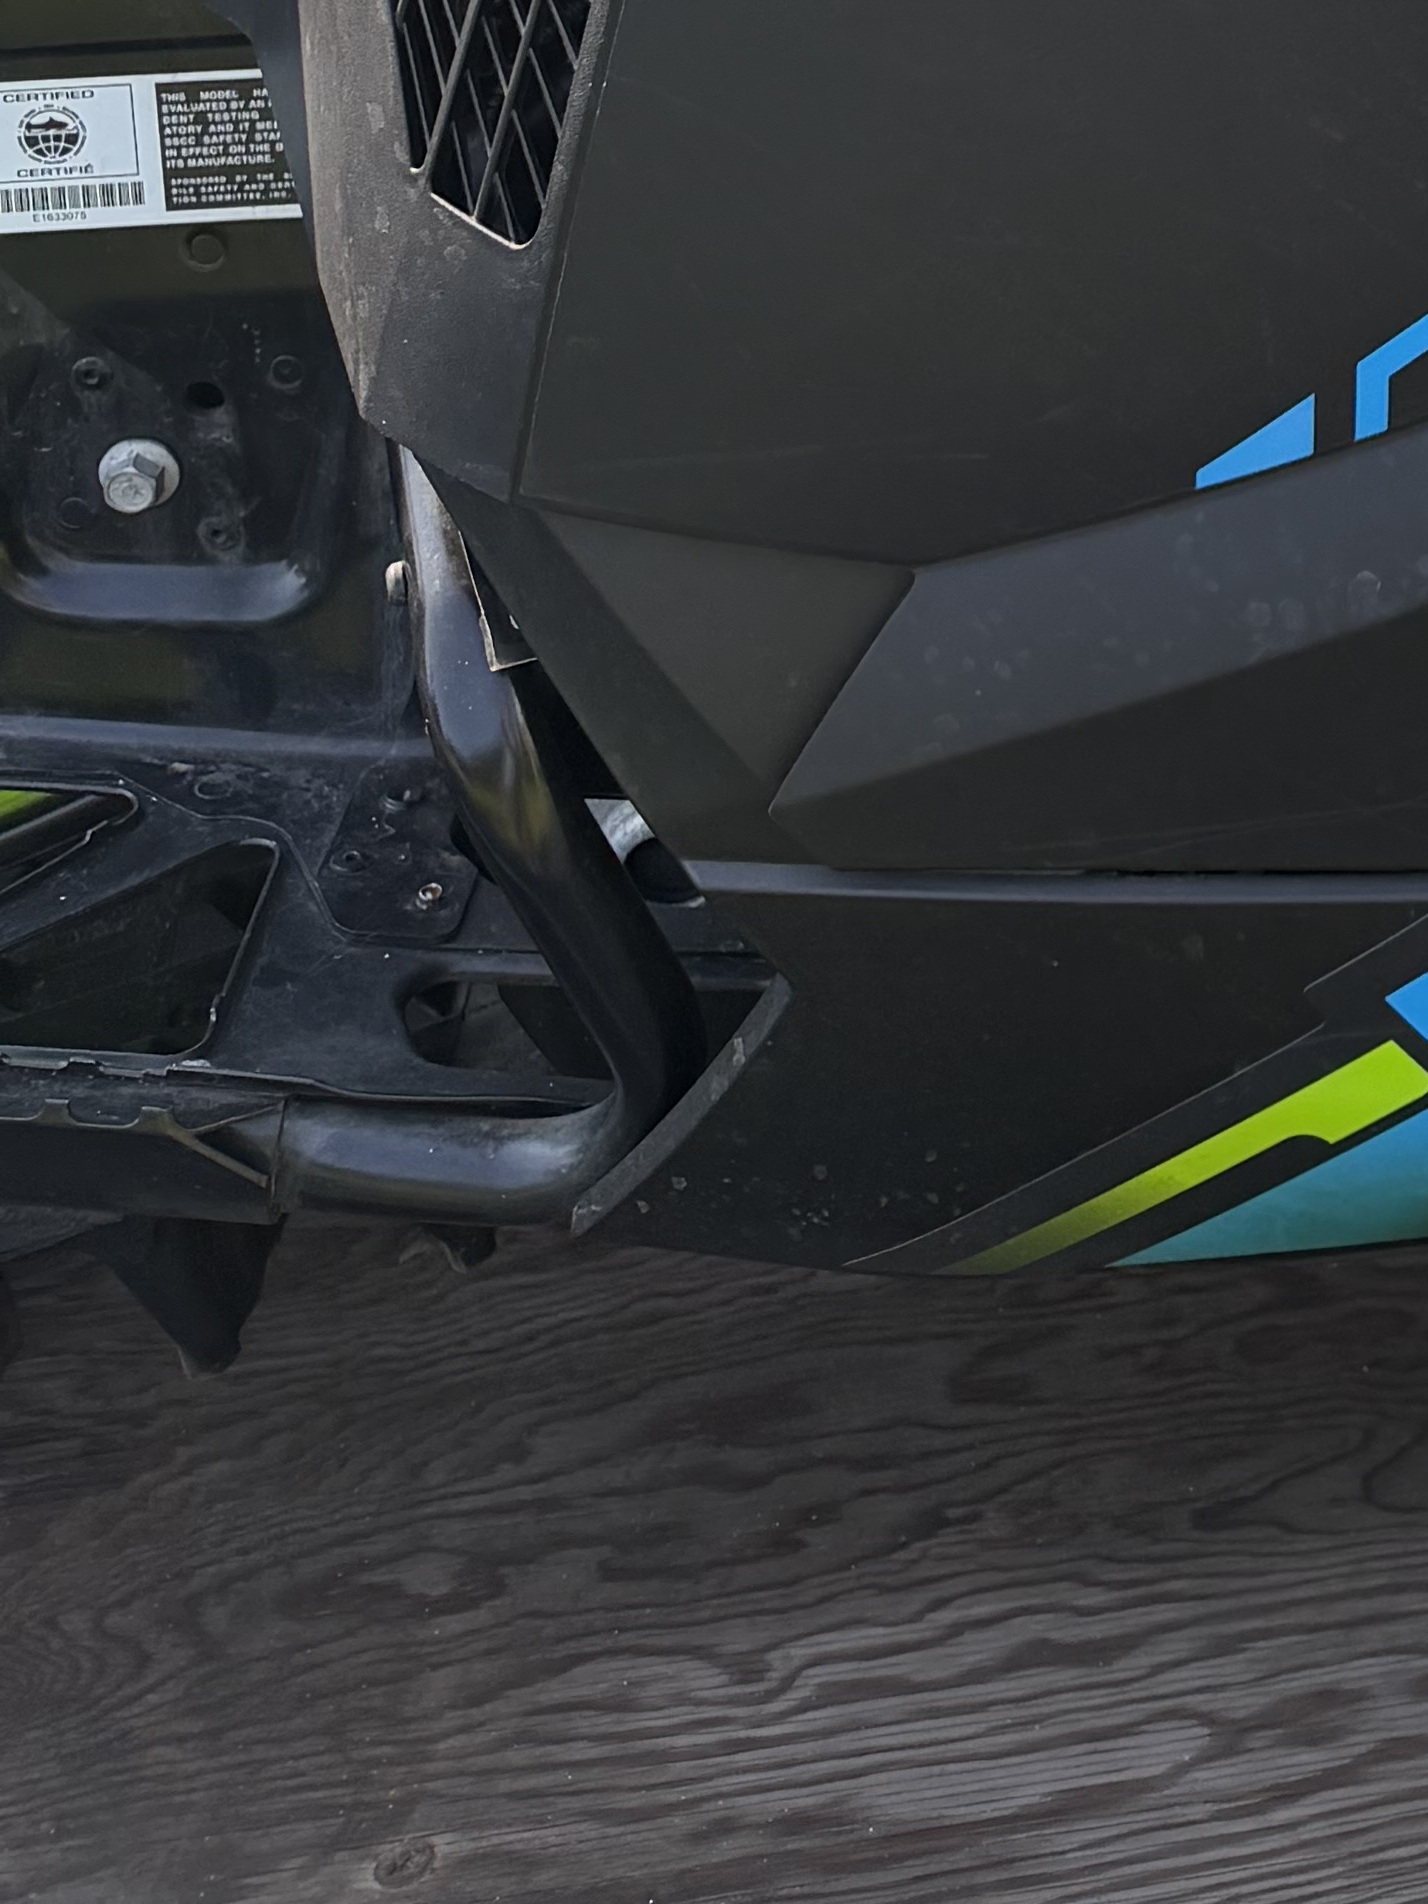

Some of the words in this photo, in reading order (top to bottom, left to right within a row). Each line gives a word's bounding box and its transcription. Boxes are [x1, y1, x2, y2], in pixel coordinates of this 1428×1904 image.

[3, 89, 95, 103] CERTIFIED
[160, 92, 186, 102] THIS
[200, 90, 239, 101] MODEL
[253, 88, 269, 97] HA
[161, 102, 227, 113] EVALUATED
[230, 100, 245, 110] BY
[248, 99, 265, 109] AN
[163, 114, 195, 125] DENT
[207, 110, 260, 122] TESTING
[164, 124, 203, 135] ATORY
[208, 123, 234, 133] AND
[239, 121, 251, 131] IT
[202, 133, 248, 144] SAFETY
[165, 148, 178, 157] IN
[181, 144, 224, 156] EFFECT
[229, 143, 246, 153] ON
[249, 142, 271, 152] THE
[166, 159, 185, 169] ITS
[187, 154, 275, 167] MANUFACTURE.
[16, 162, 95, 178] CERTIFIÉ
